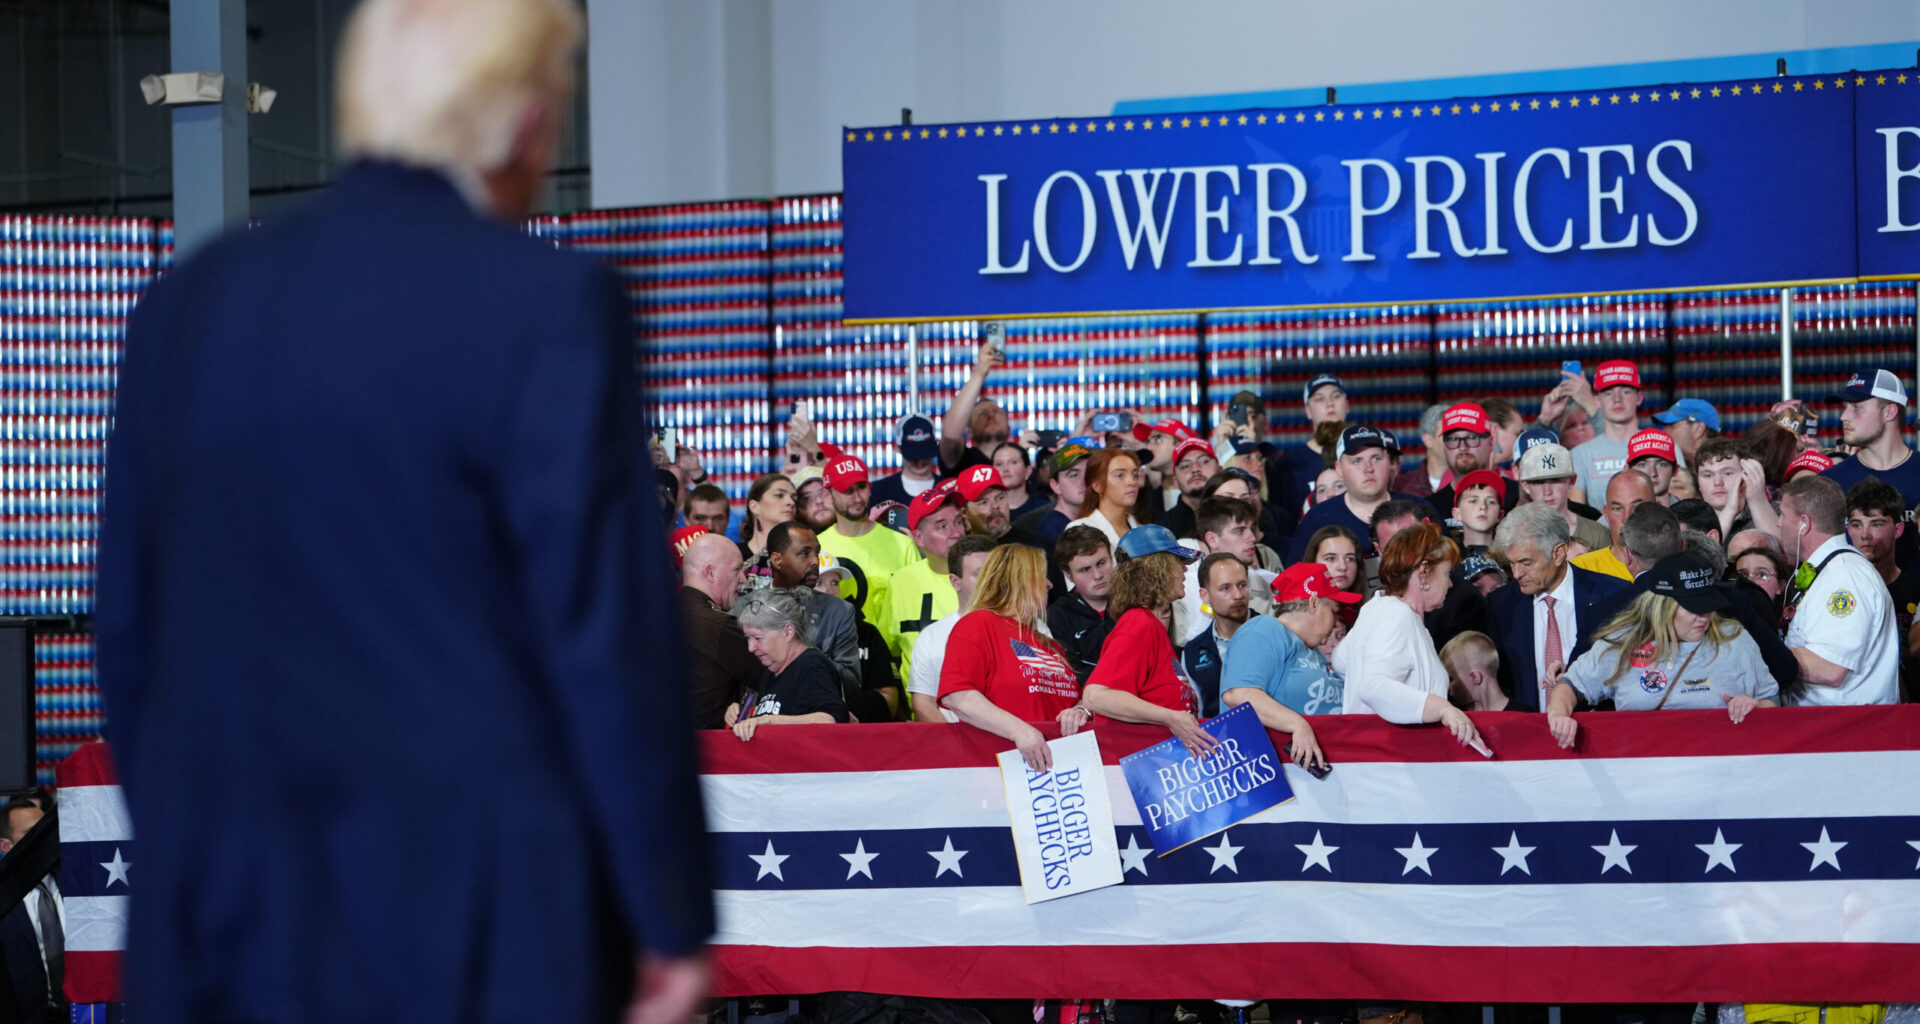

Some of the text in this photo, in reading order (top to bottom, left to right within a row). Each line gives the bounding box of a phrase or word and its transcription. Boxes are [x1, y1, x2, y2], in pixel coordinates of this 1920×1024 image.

[977, 139, 1699, 275] LOWER PRICES
[1600, 366, 1634, 376] MAKE AMERICA
[1458, 408, 1480, 418] AMERICA
[1631, 432, 1673, 445] MAKE AMERICA
[1633, 441, 1670, 452] GREAT AGAIN
[835, 460, 864, 475] USA
[972, 467, 993, 483] 47
[1680, 570, 1700, 580] Make
[1684, 579, 1705, 590] Great
[1156, 738, 1248, 795] BIGGER
[1144, 753, 1277, 832] PAYCHECKS
[1055, 767, 1093, 863] BIGGER
[1023, 756, 1071, 890] AYCHECKS
